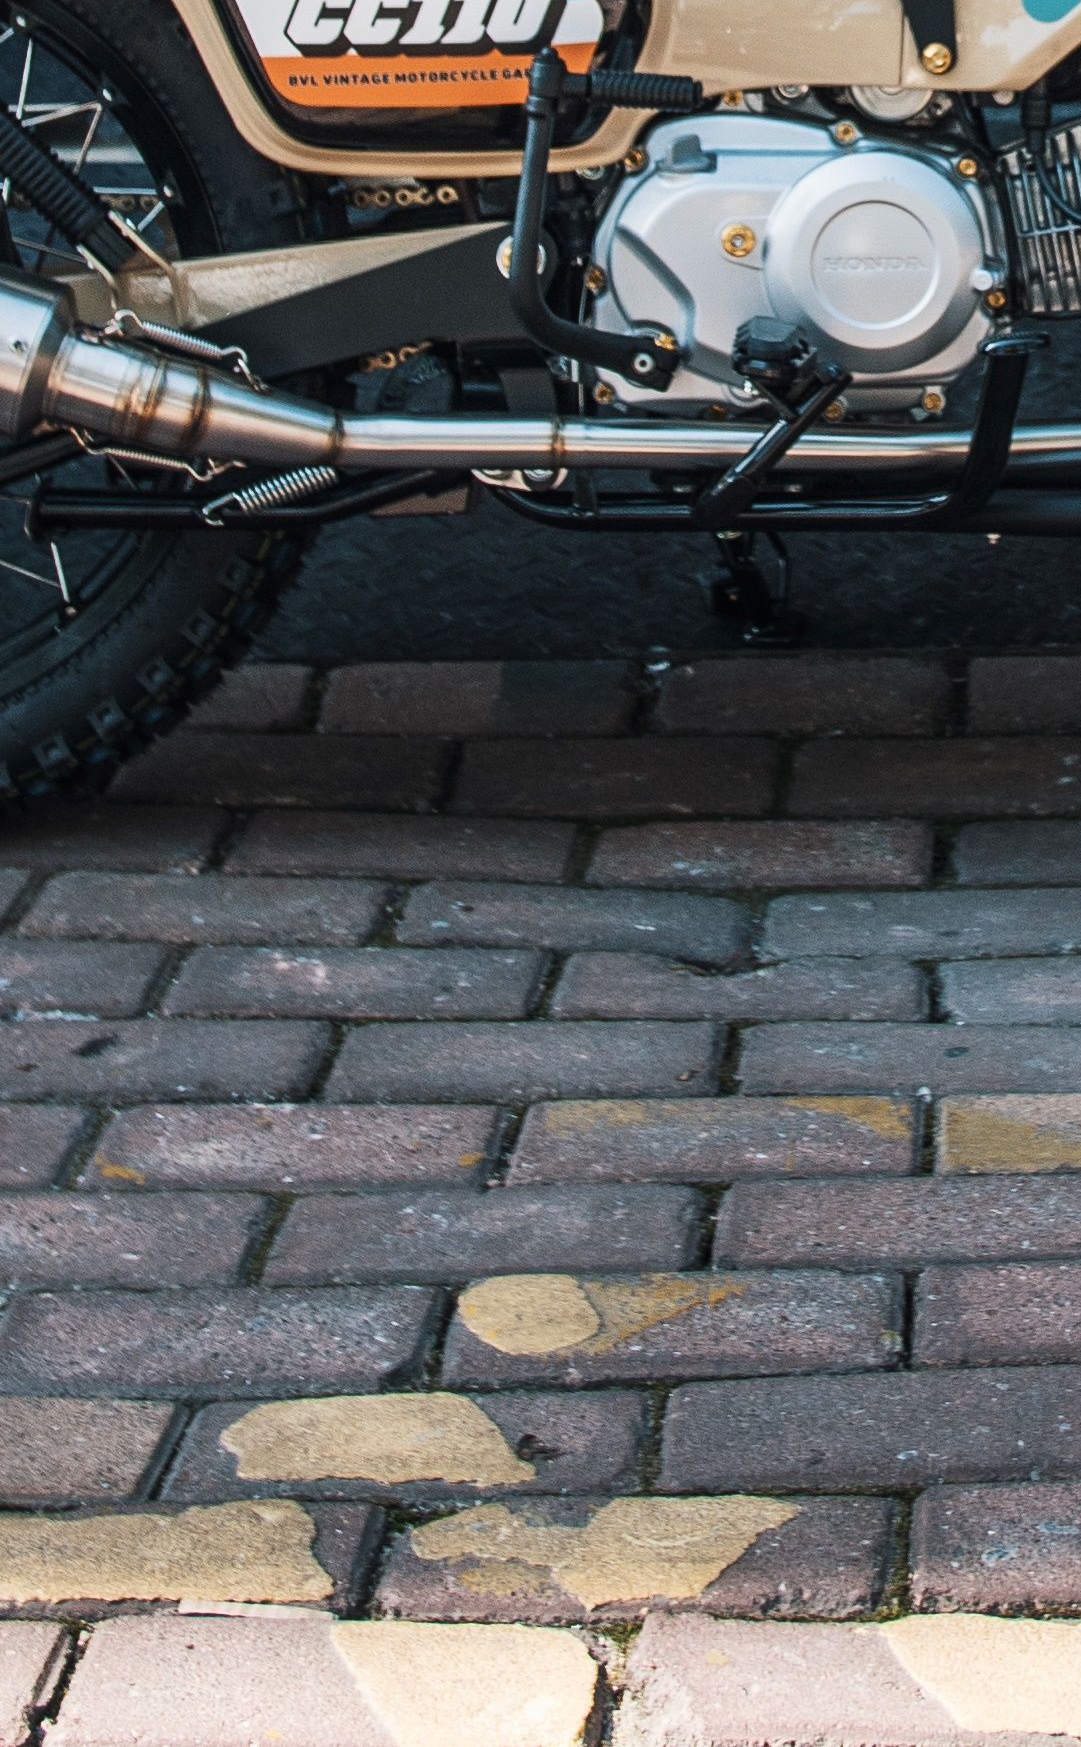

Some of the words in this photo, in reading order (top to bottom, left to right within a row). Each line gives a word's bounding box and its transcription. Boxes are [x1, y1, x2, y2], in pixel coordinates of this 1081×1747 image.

[289, 75, 319, 87] BVL
[322, 72, 390, 85] VINTAGE
[394, 68, 498, 83] MOTORCYCLE
